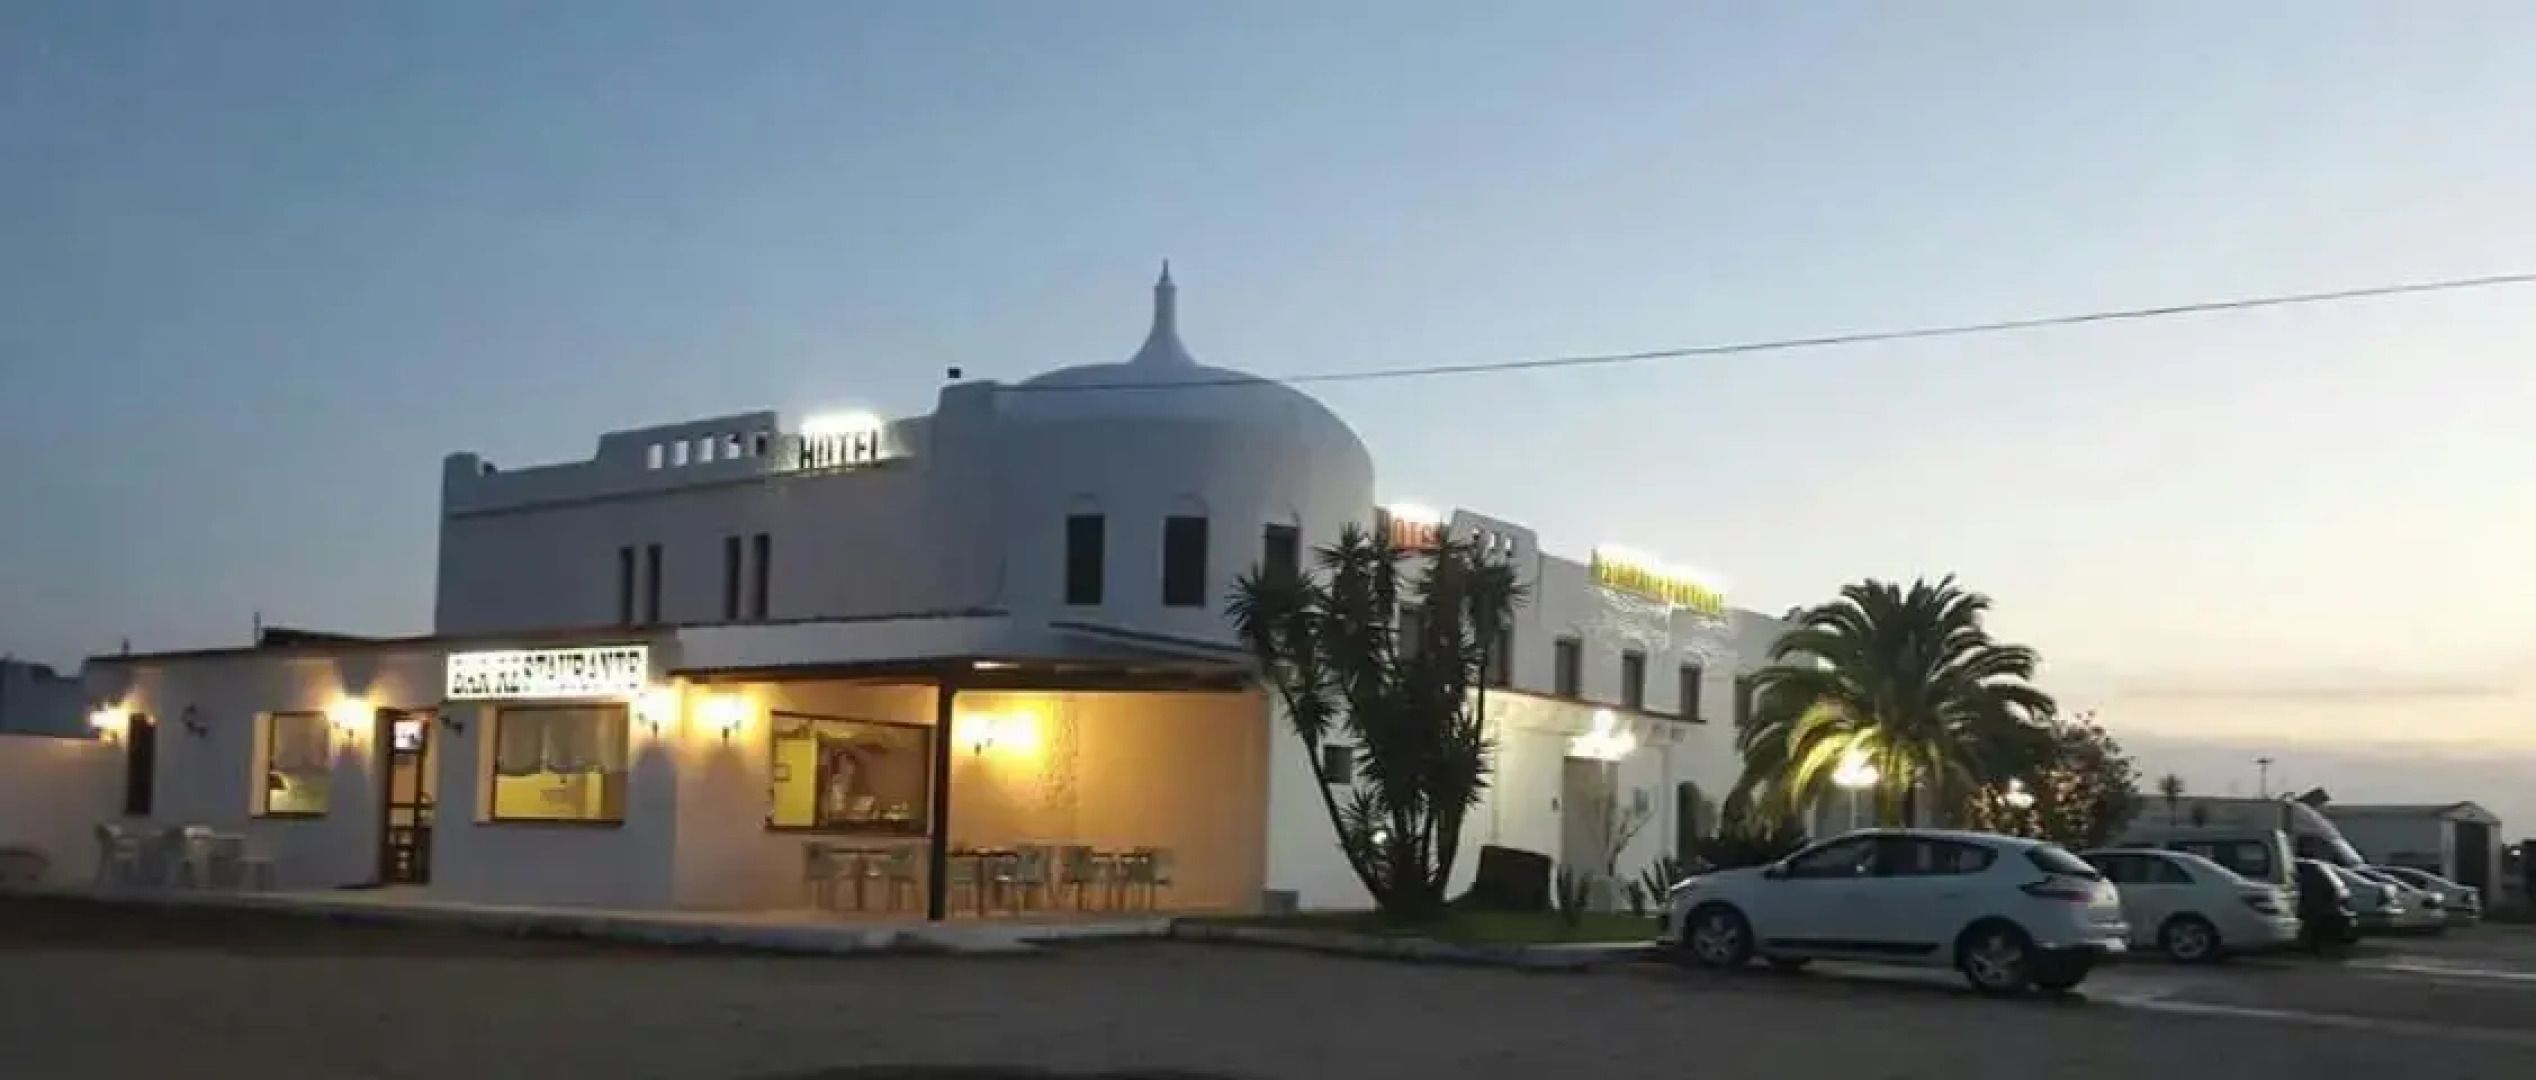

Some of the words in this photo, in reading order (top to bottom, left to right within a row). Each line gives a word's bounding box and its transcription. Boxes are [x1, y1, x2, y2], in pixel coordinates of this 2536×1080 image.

[799, 430, 881, 470] HOTEL
[452, 653, 491, 694] BAR
[495, 650, 640, 692] RESTAURANTE
